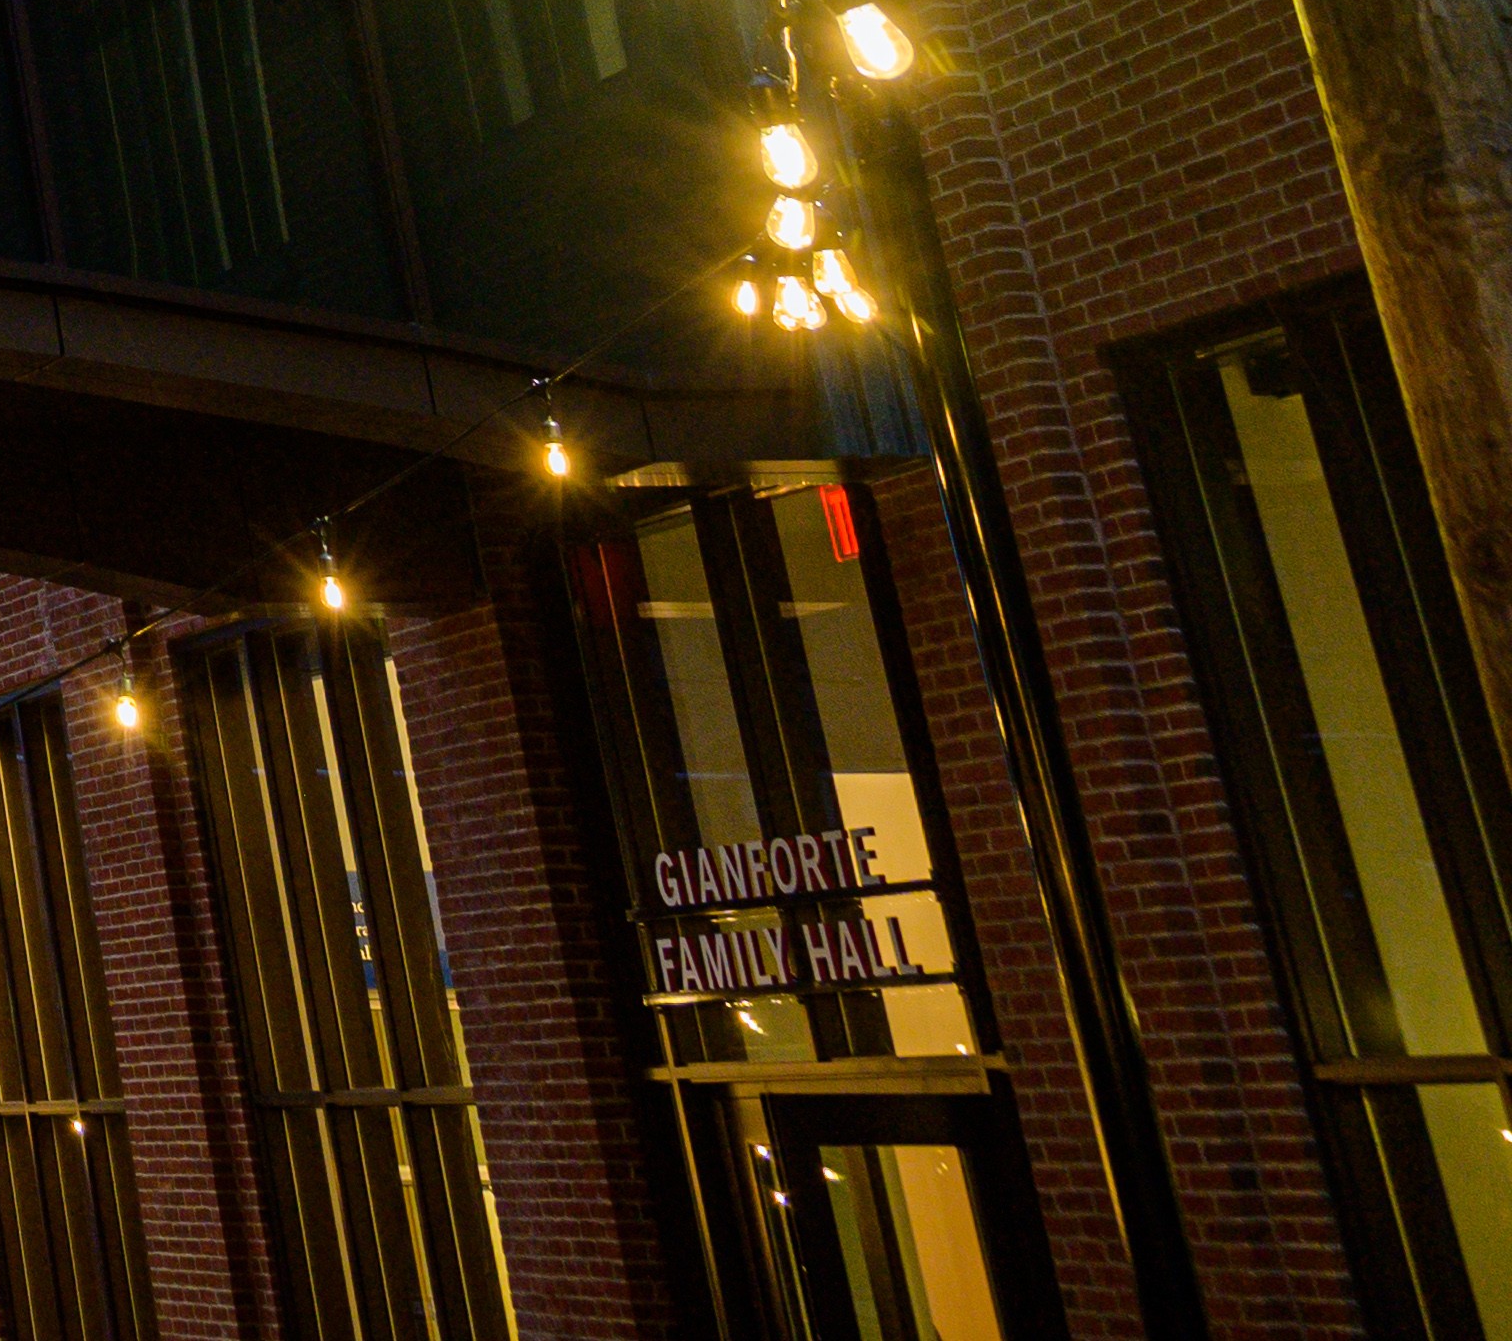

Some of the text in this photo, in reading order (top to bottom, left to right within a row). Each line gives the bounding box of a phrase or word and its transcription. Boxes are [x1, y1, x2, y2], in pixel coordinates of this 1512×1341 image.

[654, 826, 884, 907] GIANFORTE
[655, 916, 922, 993] FAMILY HALL
